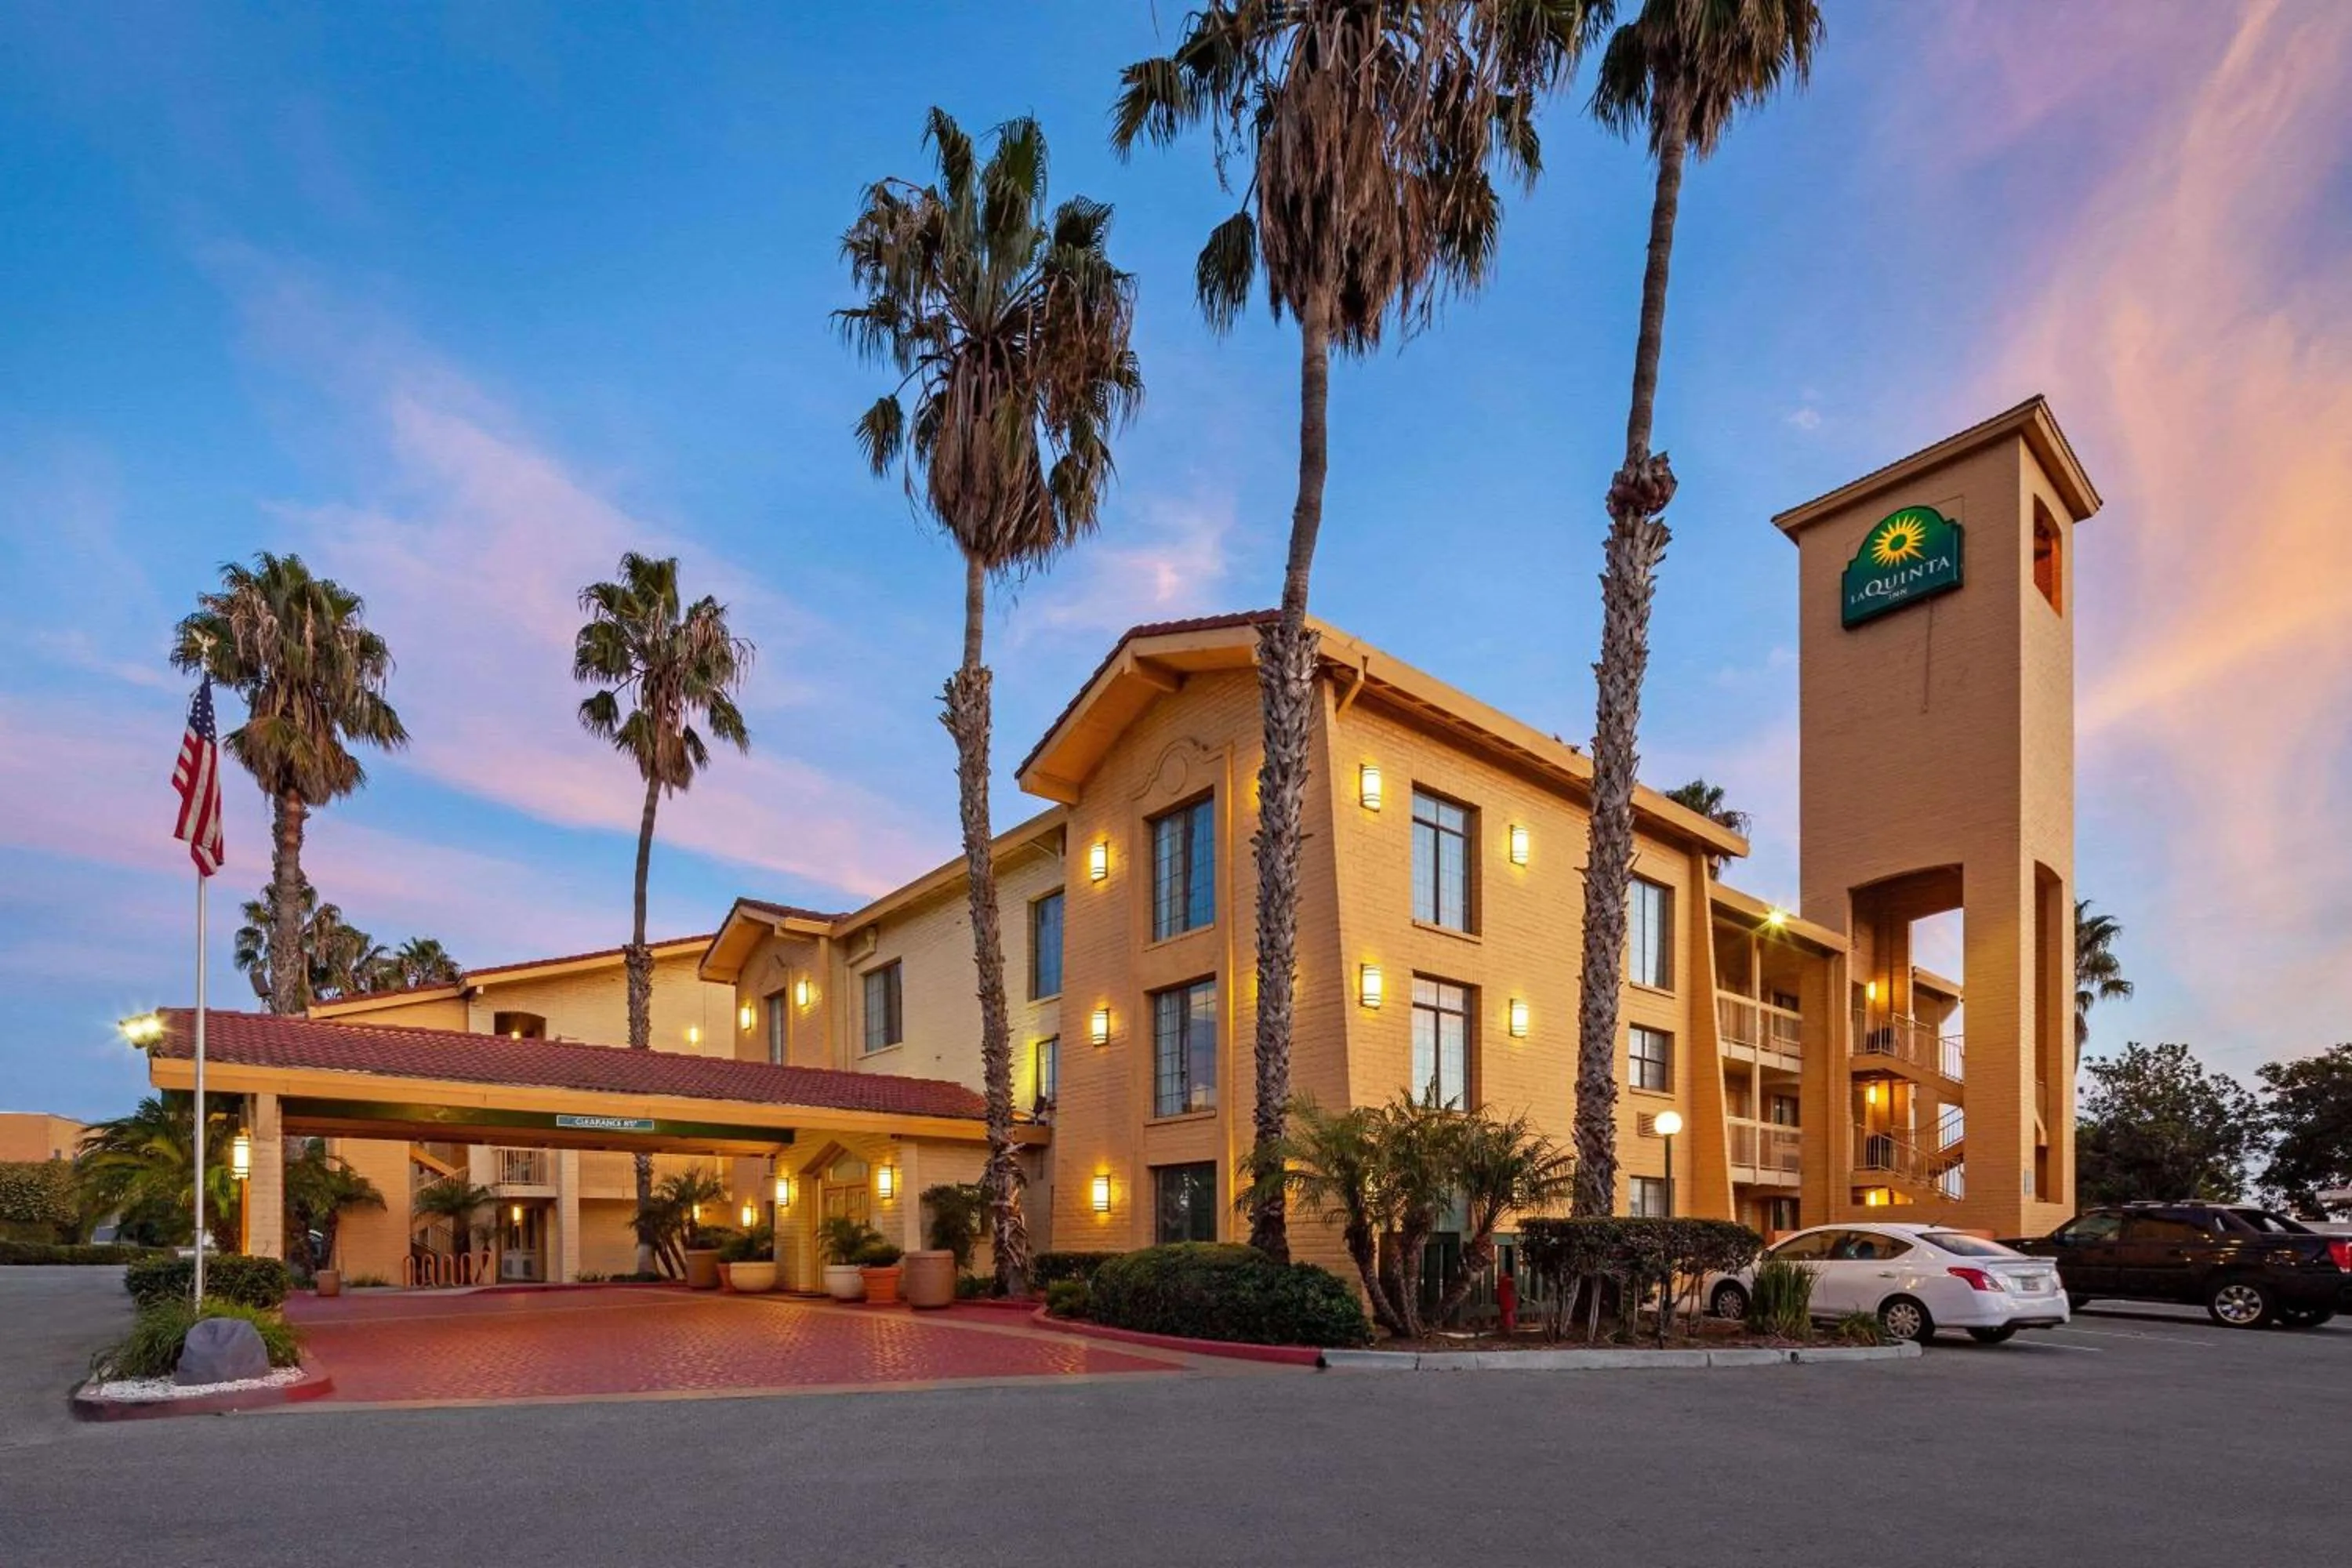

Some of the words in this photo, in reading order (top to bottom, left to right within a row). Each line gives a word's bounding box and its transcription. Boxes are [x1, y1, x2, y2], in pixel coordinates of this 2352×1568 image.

[1850, 593, 1865, 604] LA
[1865, 556, 1950, 597] QUINTA
[1887, 588, 1907, 600] INN
